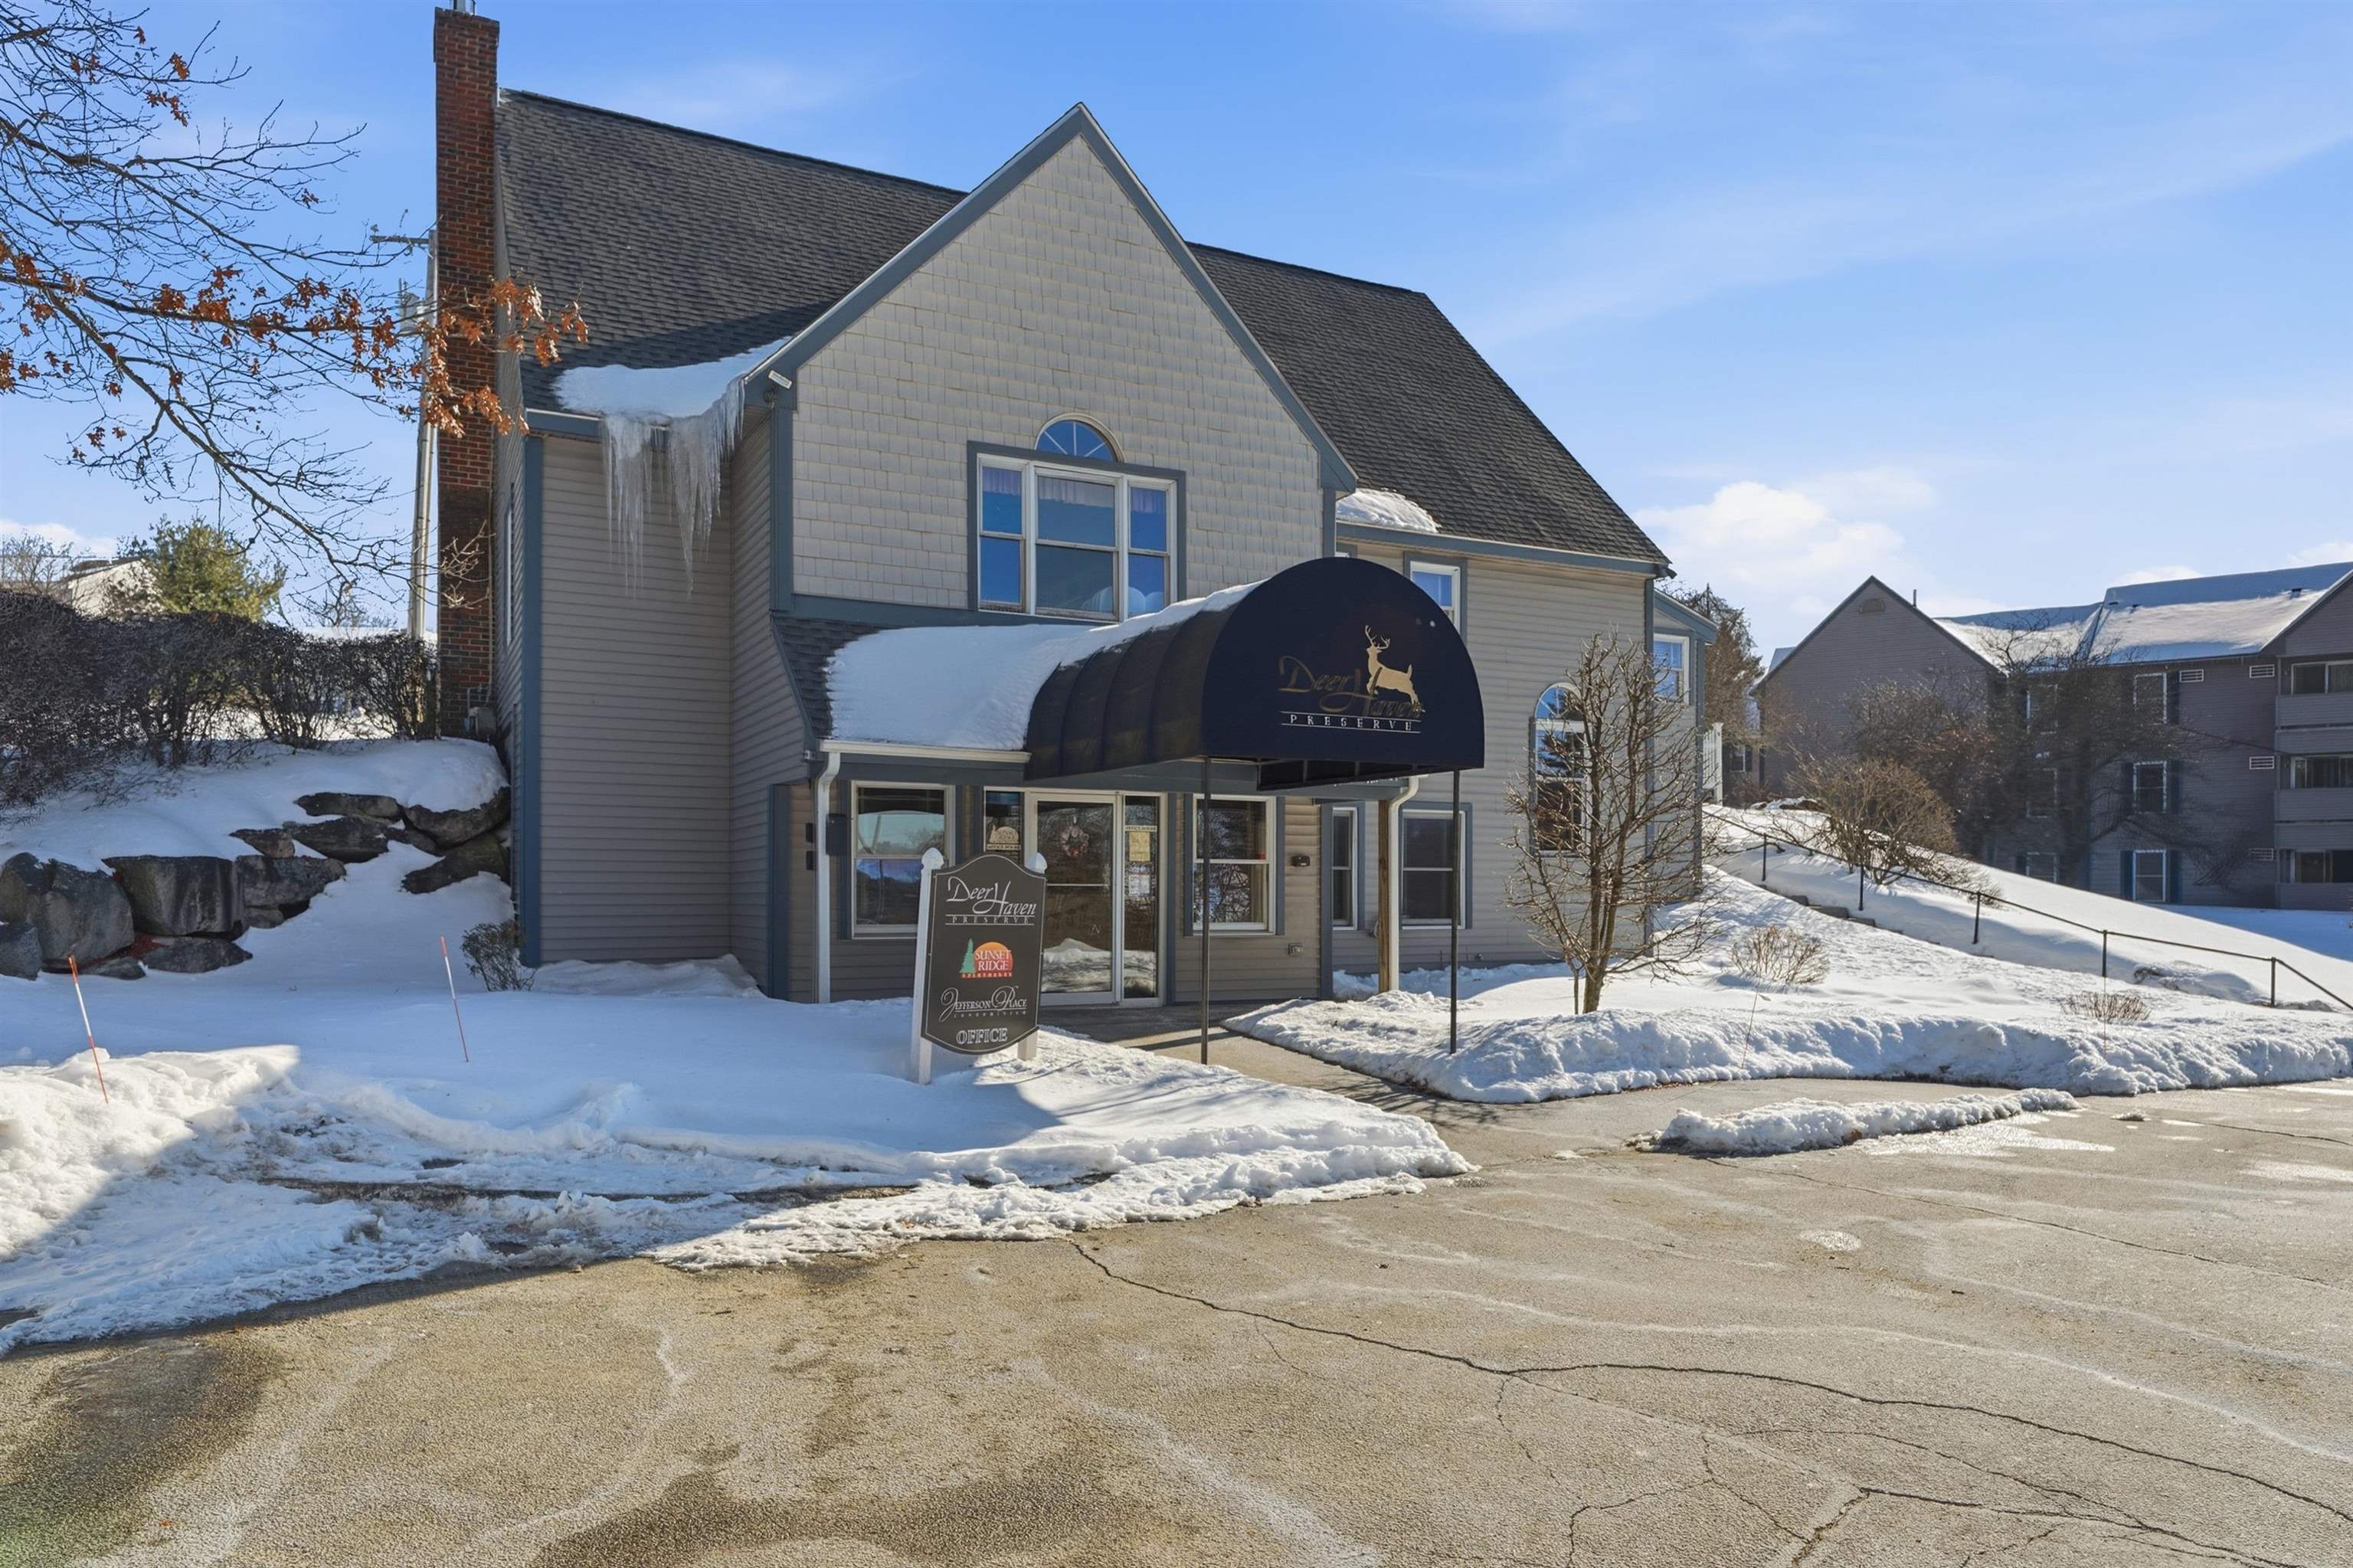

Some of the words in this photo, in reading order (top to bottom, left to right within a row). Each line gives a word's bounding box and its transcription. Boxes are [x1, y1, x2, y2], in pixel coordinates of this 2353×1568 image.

[1278, 655, 1353, 692] Deer
[1290, 714, 1412, 732] PRESERVE
[946, 876, 993, 902] Deer
[972, 880, 1037, 917] Haven
[952, 915, 1029, 924] PRESERVE
[975, 950, 1012, 961] SUNSET
[978, 961, 1010, 971] RIDGE
[938, 987, 991, 1023] JEFFERSON
[991, 986, 1027, 1011] PLACE
[956, 1028, 1008, 1045] OFFICE
